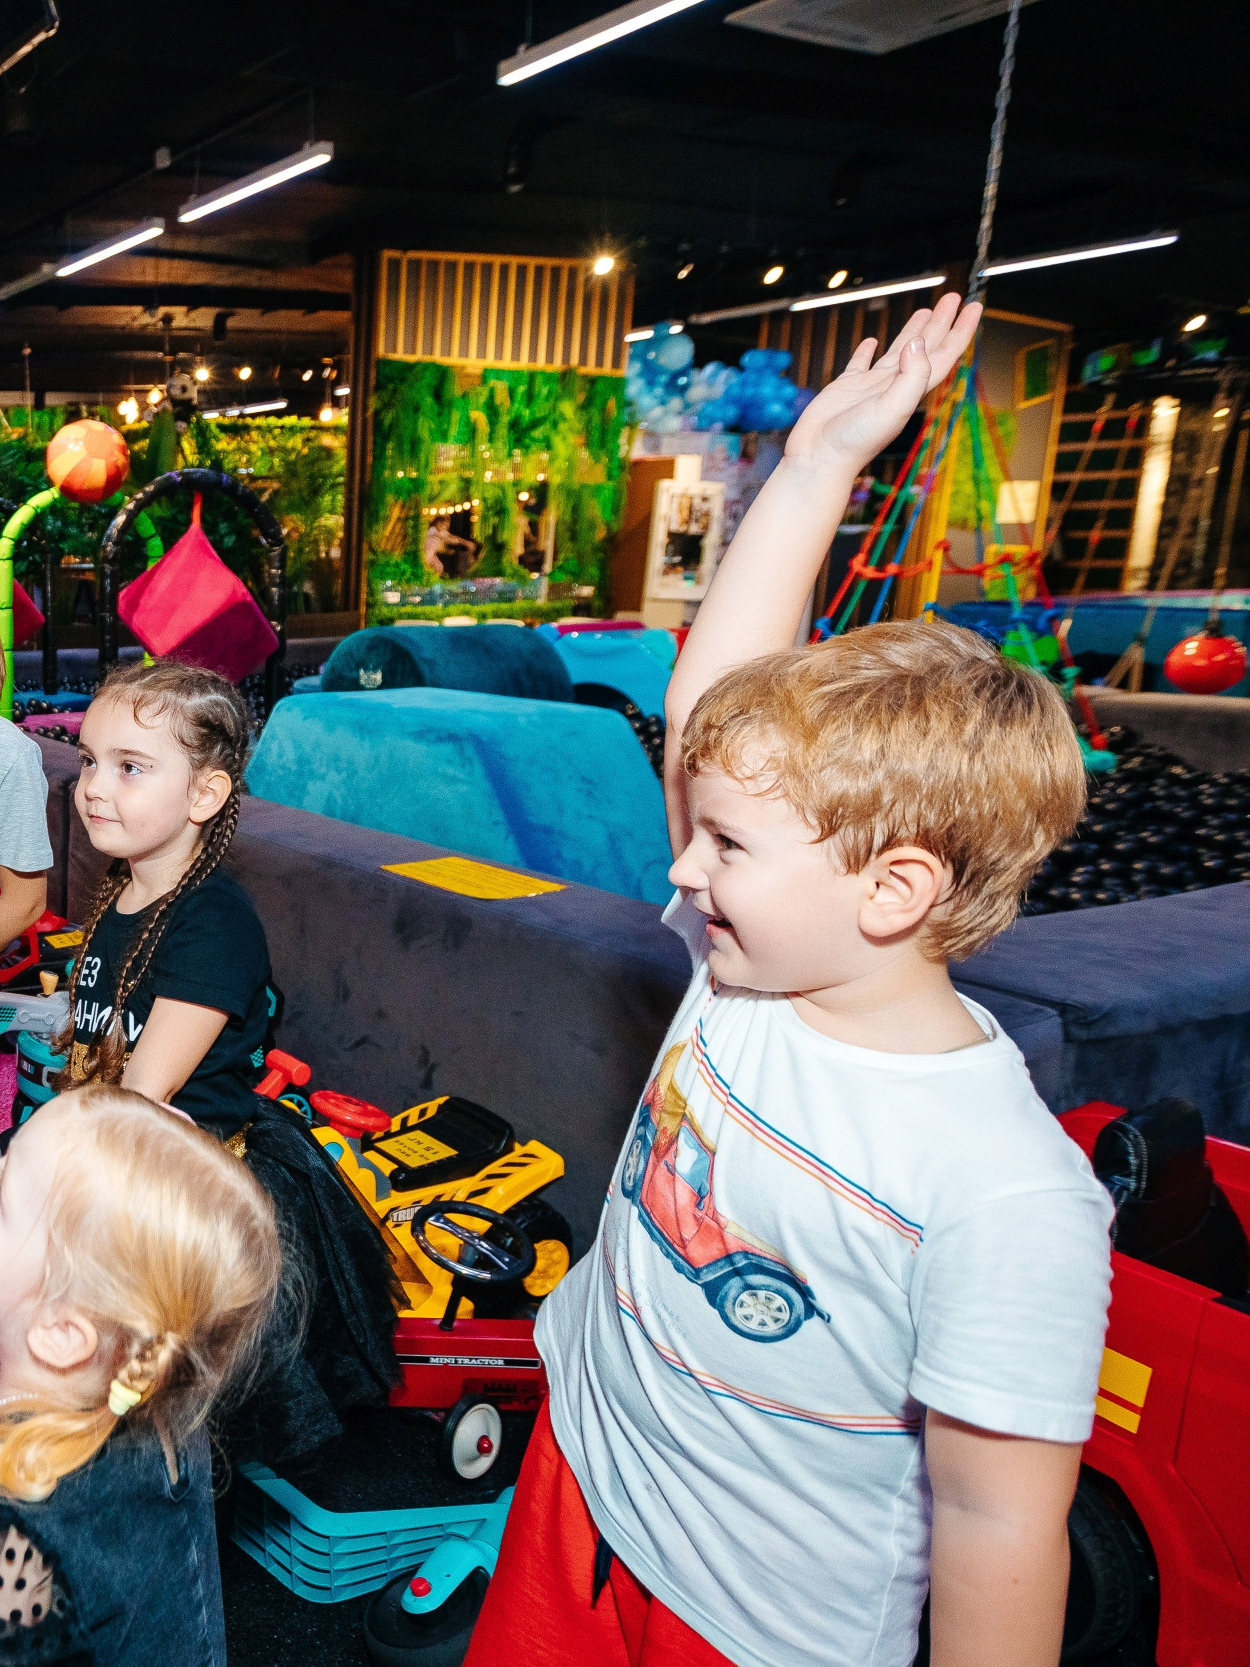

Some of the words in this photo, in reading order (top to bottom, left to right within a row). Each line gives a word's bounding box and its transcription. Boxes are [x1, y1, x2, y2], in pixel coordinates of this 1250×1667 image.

[79, 956, 101, 988] ЕЗ
[423, 1145, 439, 1155] 15
[429, 1357, 455, 1365] MINI
[456, 1358, 505, 1366] TRACTOR
